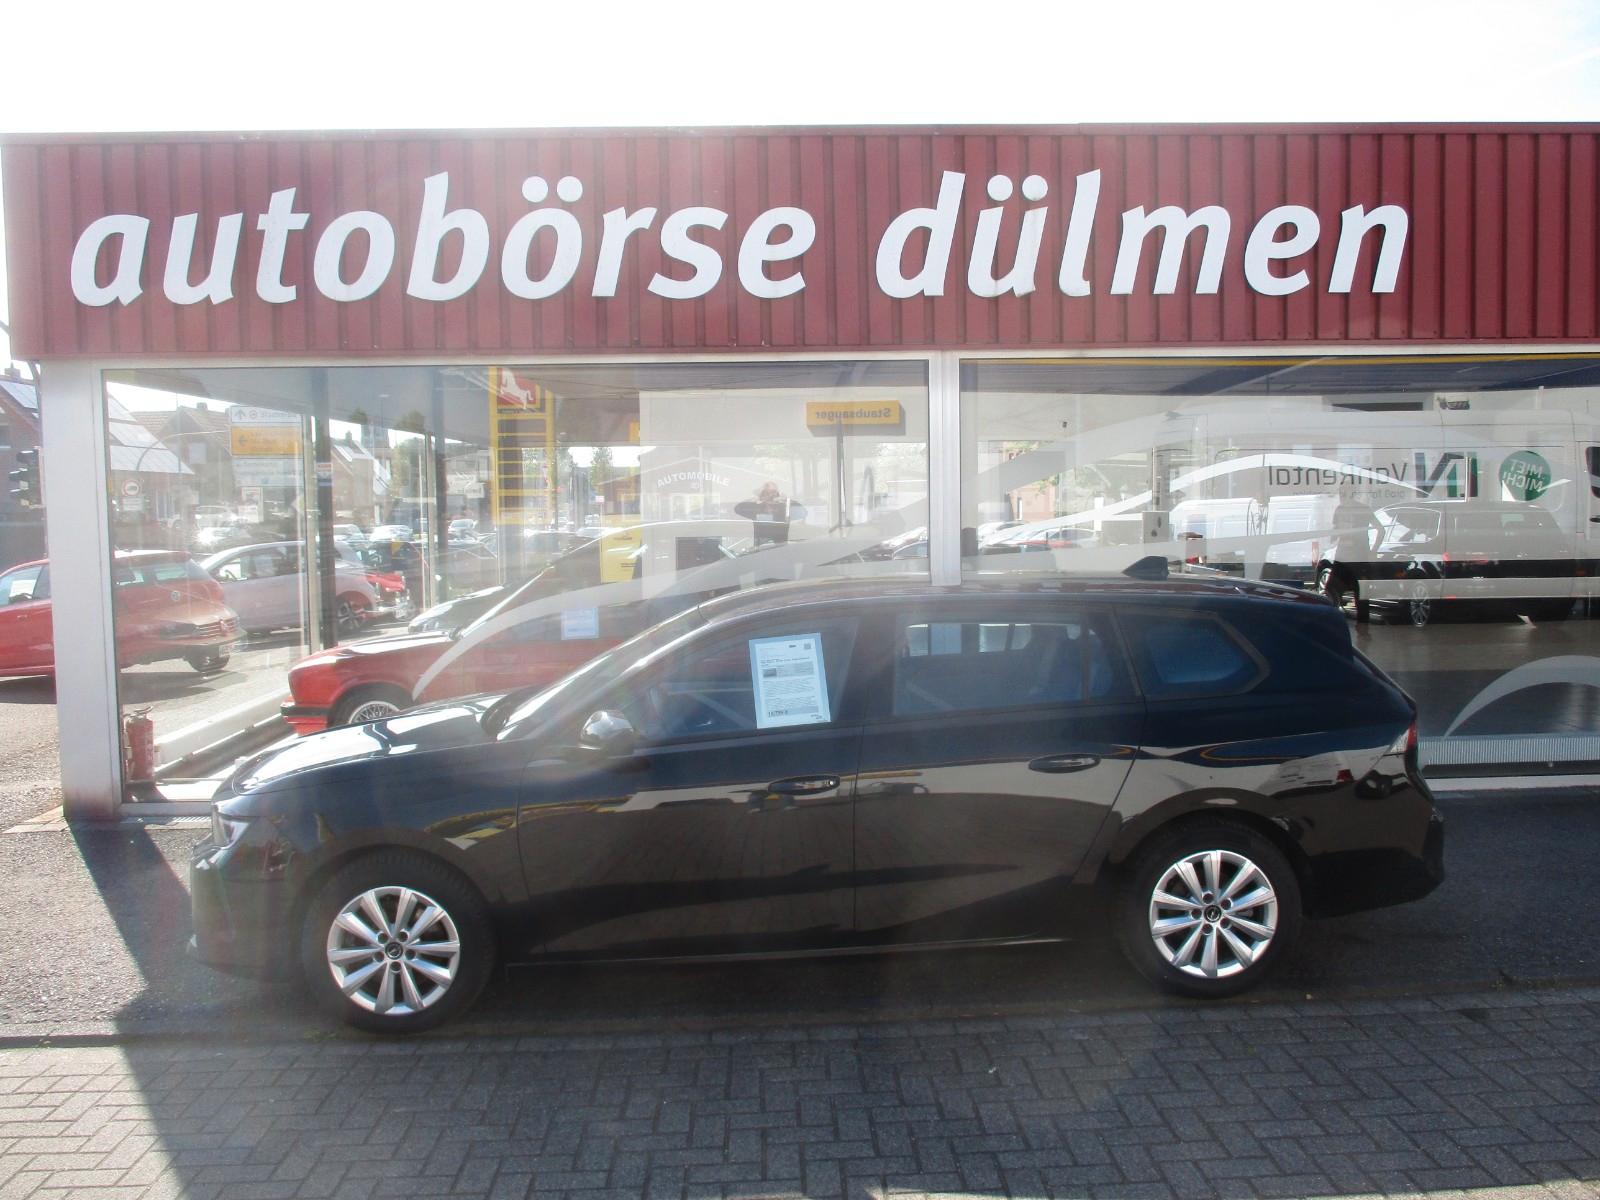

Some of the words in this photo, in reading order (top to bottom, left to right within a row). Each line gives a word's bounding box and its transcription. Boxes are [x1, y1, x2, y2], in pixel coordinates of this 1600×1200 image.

[71, 171, 816, 306] autobörse
[876, 169, 1410, 299] dülmen
[657, 472, 729, 488] AUTOMOBILE
